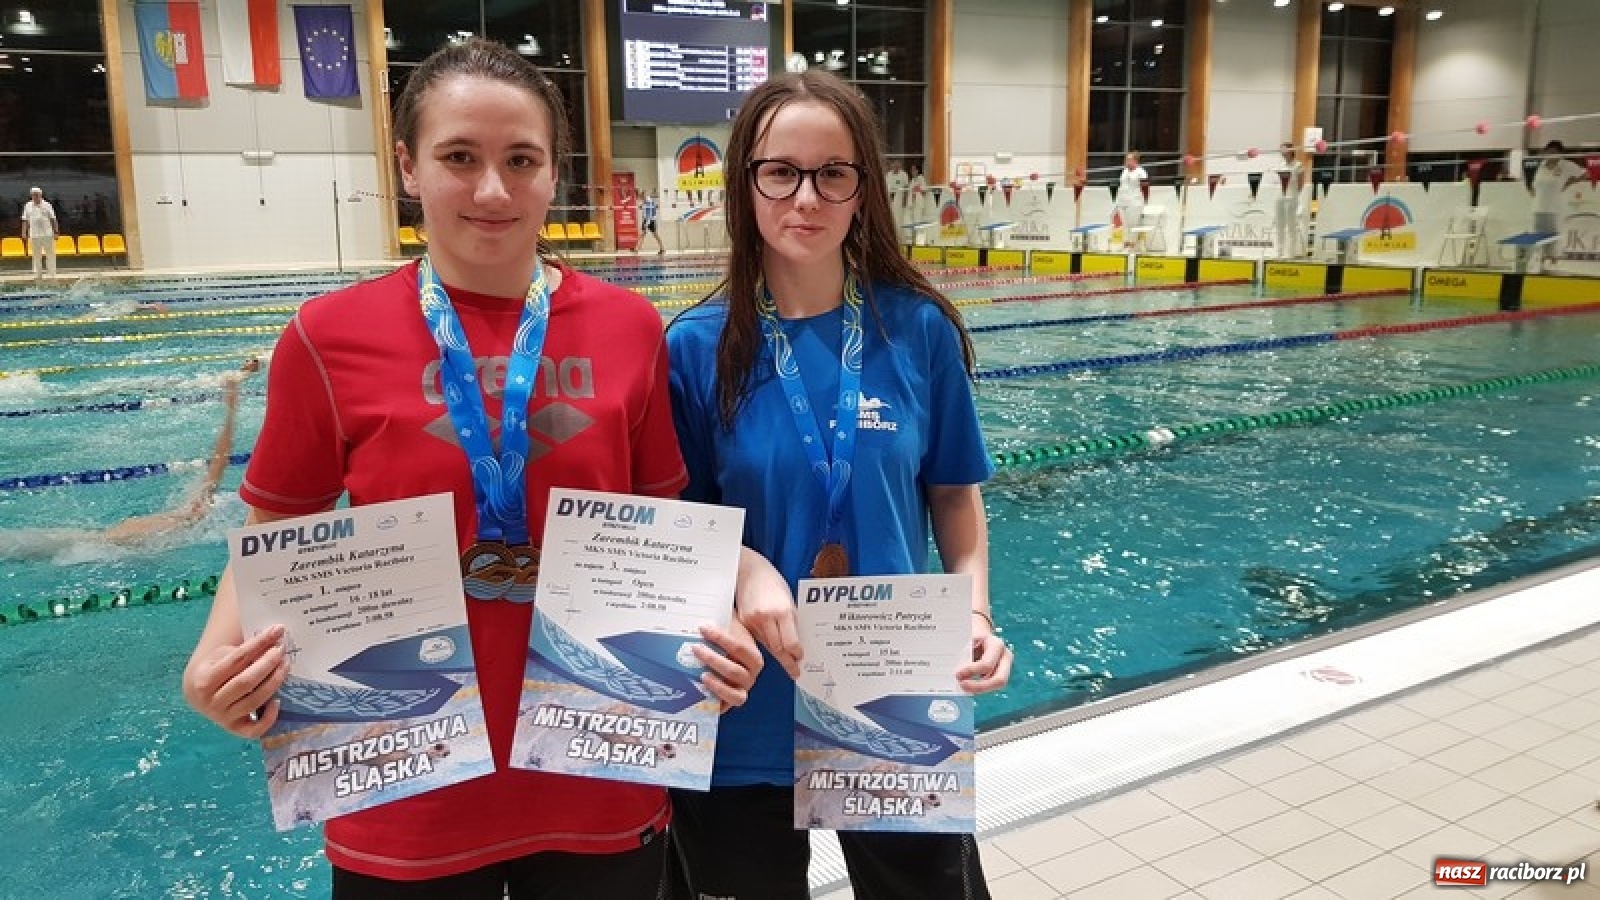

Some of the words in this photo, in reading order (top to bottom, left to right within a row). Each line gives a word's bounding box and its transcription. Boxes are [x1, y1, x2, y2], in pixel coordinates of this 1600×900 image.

[1268, 266, 1300, 278] OMEGA
[1428, 275, 1468, 288] OMEGA
[556, 497, 656, 525] DYPLOM
[241, 517, 355, 557] DYPLOM
[290, 551, 345, 573] Zarembik
[349, 543, 405, 563] Katarzyna
[806, 583, 893, 603] DYPLOM
[532, 705, 699, 745] MISTRZOSTWA
[286, 713, 468, 782] MISTRZOSTWA
[566, 732, 656, 769] ŚLĄSKA
[333, 752, 435, 798] ŚLĄSKA
[807, 770, 961, 792] MISTRZOSTWA
[842, 791, 926, 818] ŚLĄSKA
